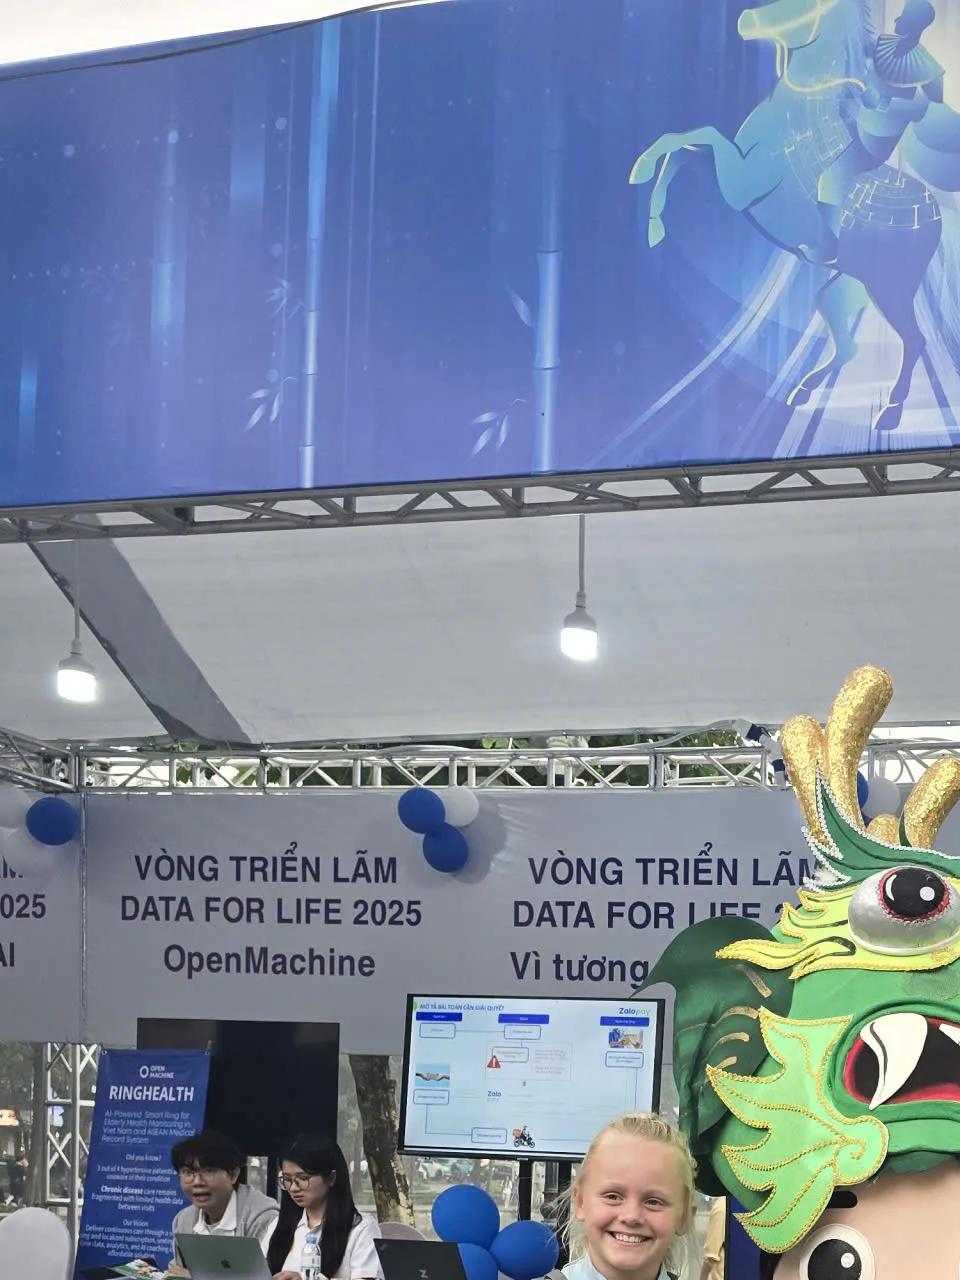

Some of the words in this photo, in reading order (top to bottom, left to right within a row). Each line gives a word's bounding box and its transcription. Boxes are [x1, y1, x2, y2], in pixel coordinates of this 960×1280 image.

[135, 848, 218, 883] VÒNG
[230, 841, 325, 884] TRIỂN
[334, 850, 397, 884] LÃM
[528, 849, 623, 886] VÒNG
[636, 841, 739, 886] TRIỂN
[0, 894, 46, 919] 025
[121, 896, 194, 922] DATA
[205, 897, 265, 923] FOR
[277, 898, 341, 925] LIFE
[353, 900, 422, 927] 2025
[513, 901, 595, 928] DATA
[608, 902, 675, 929] FOR
[164, 944, 375, 979] OpenMachine
[510, 950, 541, 981] Vì
[553, 956, 649, 989] tương
[619, 1008, 650, 1016] Zalopay
[109, 1086, 195, 1102] RINGHEALTH
[127, 1136, 149, 1144] System
